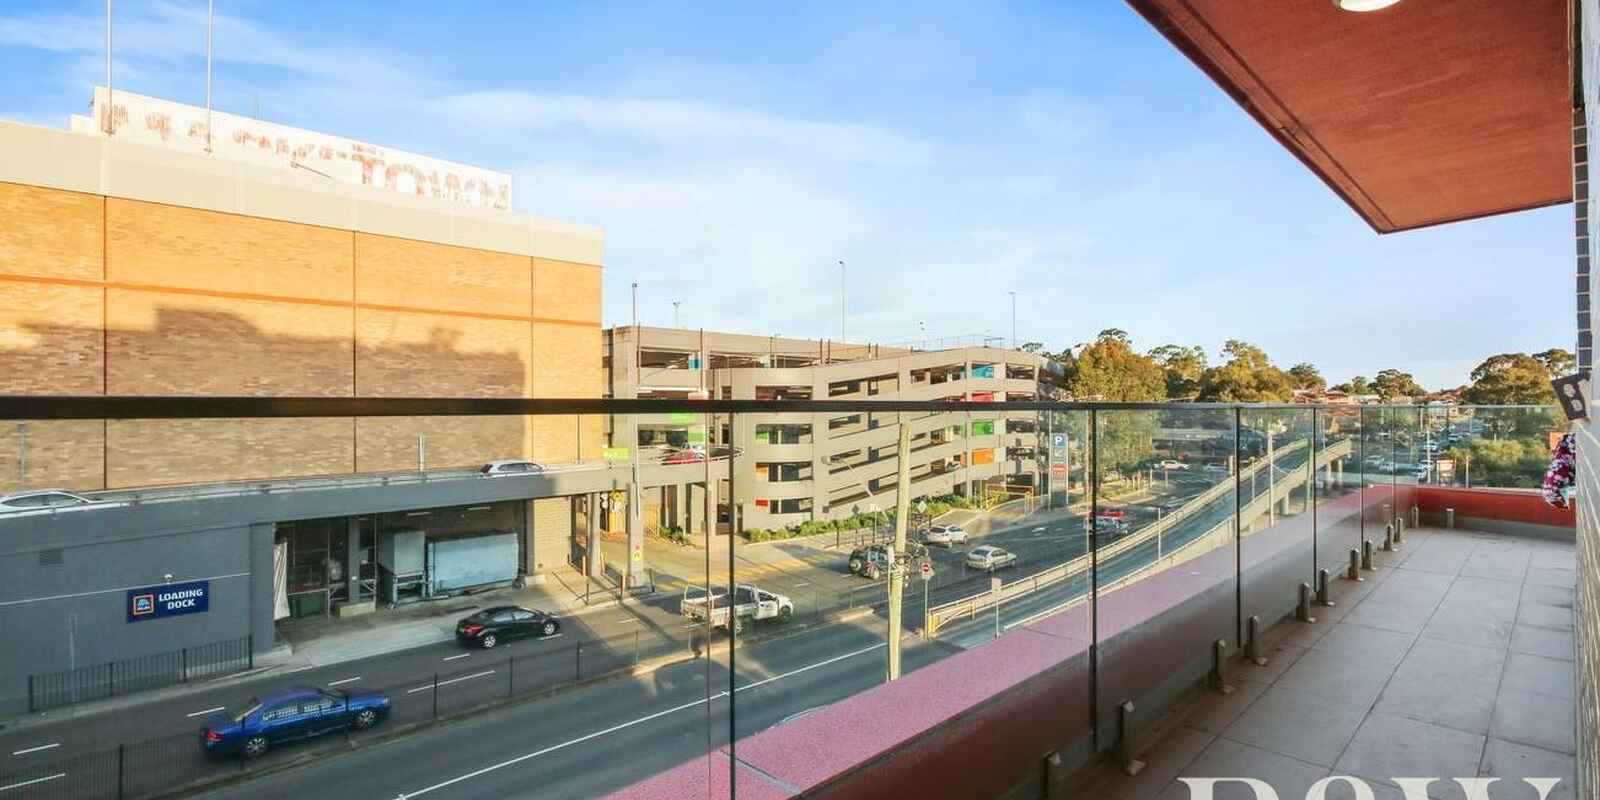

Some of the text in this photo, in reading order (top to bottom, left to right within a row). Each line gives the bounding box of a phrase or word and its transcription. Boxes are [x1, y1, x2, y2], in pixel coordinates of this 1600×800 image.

[1055, 435, 1064, 447] P
[158, 588, 204, 602] LOADING
[167, 598, 195, 610] DOCK
